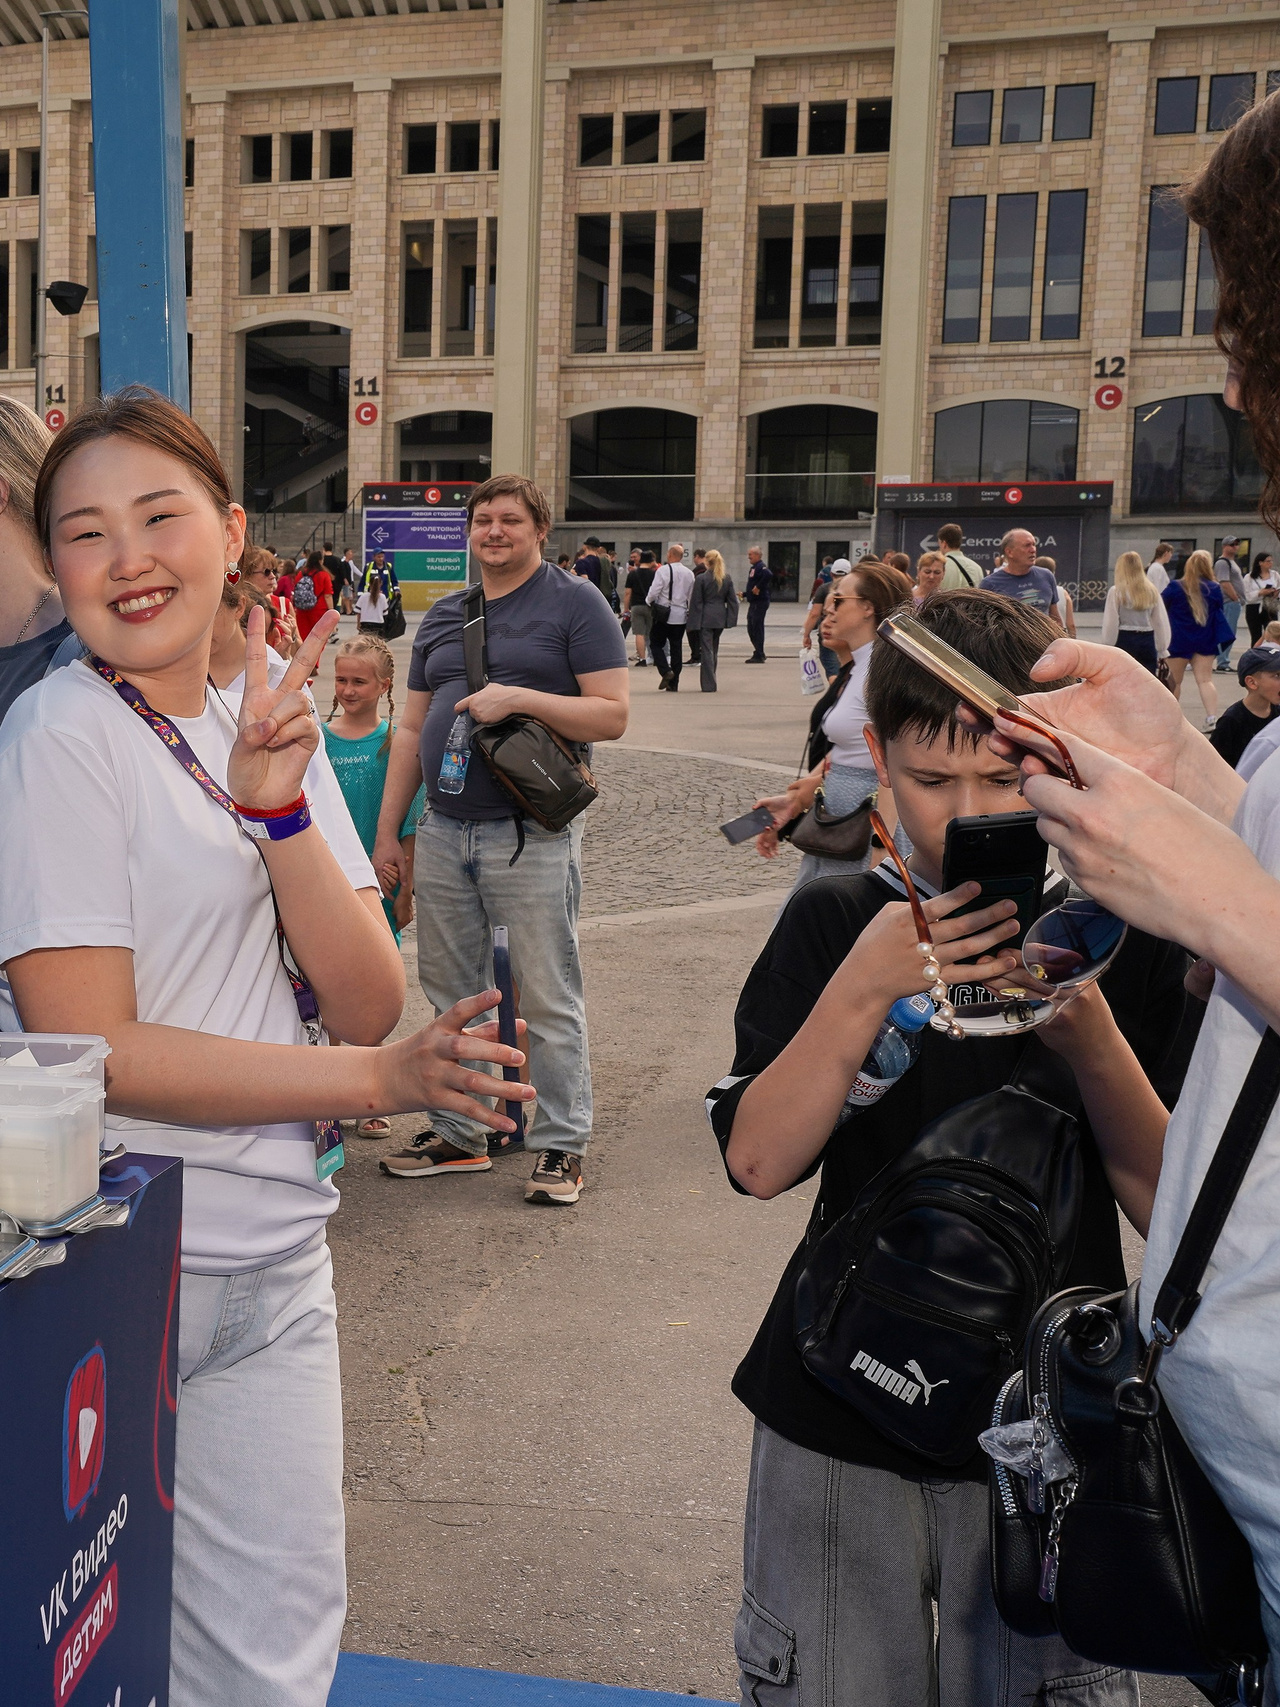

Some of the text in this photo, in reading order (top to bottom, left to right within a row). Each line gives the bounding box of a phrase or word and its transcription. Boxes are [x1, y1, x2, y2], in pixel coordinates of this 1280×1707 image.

[1094, 356, 1125, 378] 12
[45, 384, 66, 403] 11
[354, 376, 379, 396] 11
[1101, 389, 1115, 406] C
[50, 414, 59, 428] C
[360, 406, 371, 421] C
[428, 490, 437, 500] C
[1009, 490, 1018, 501] C
[849, 1349, 922, 1405] PUMA
[40, 1494, 128, 1645] VK Видео
[60, 1580, 113, 1697] детям
